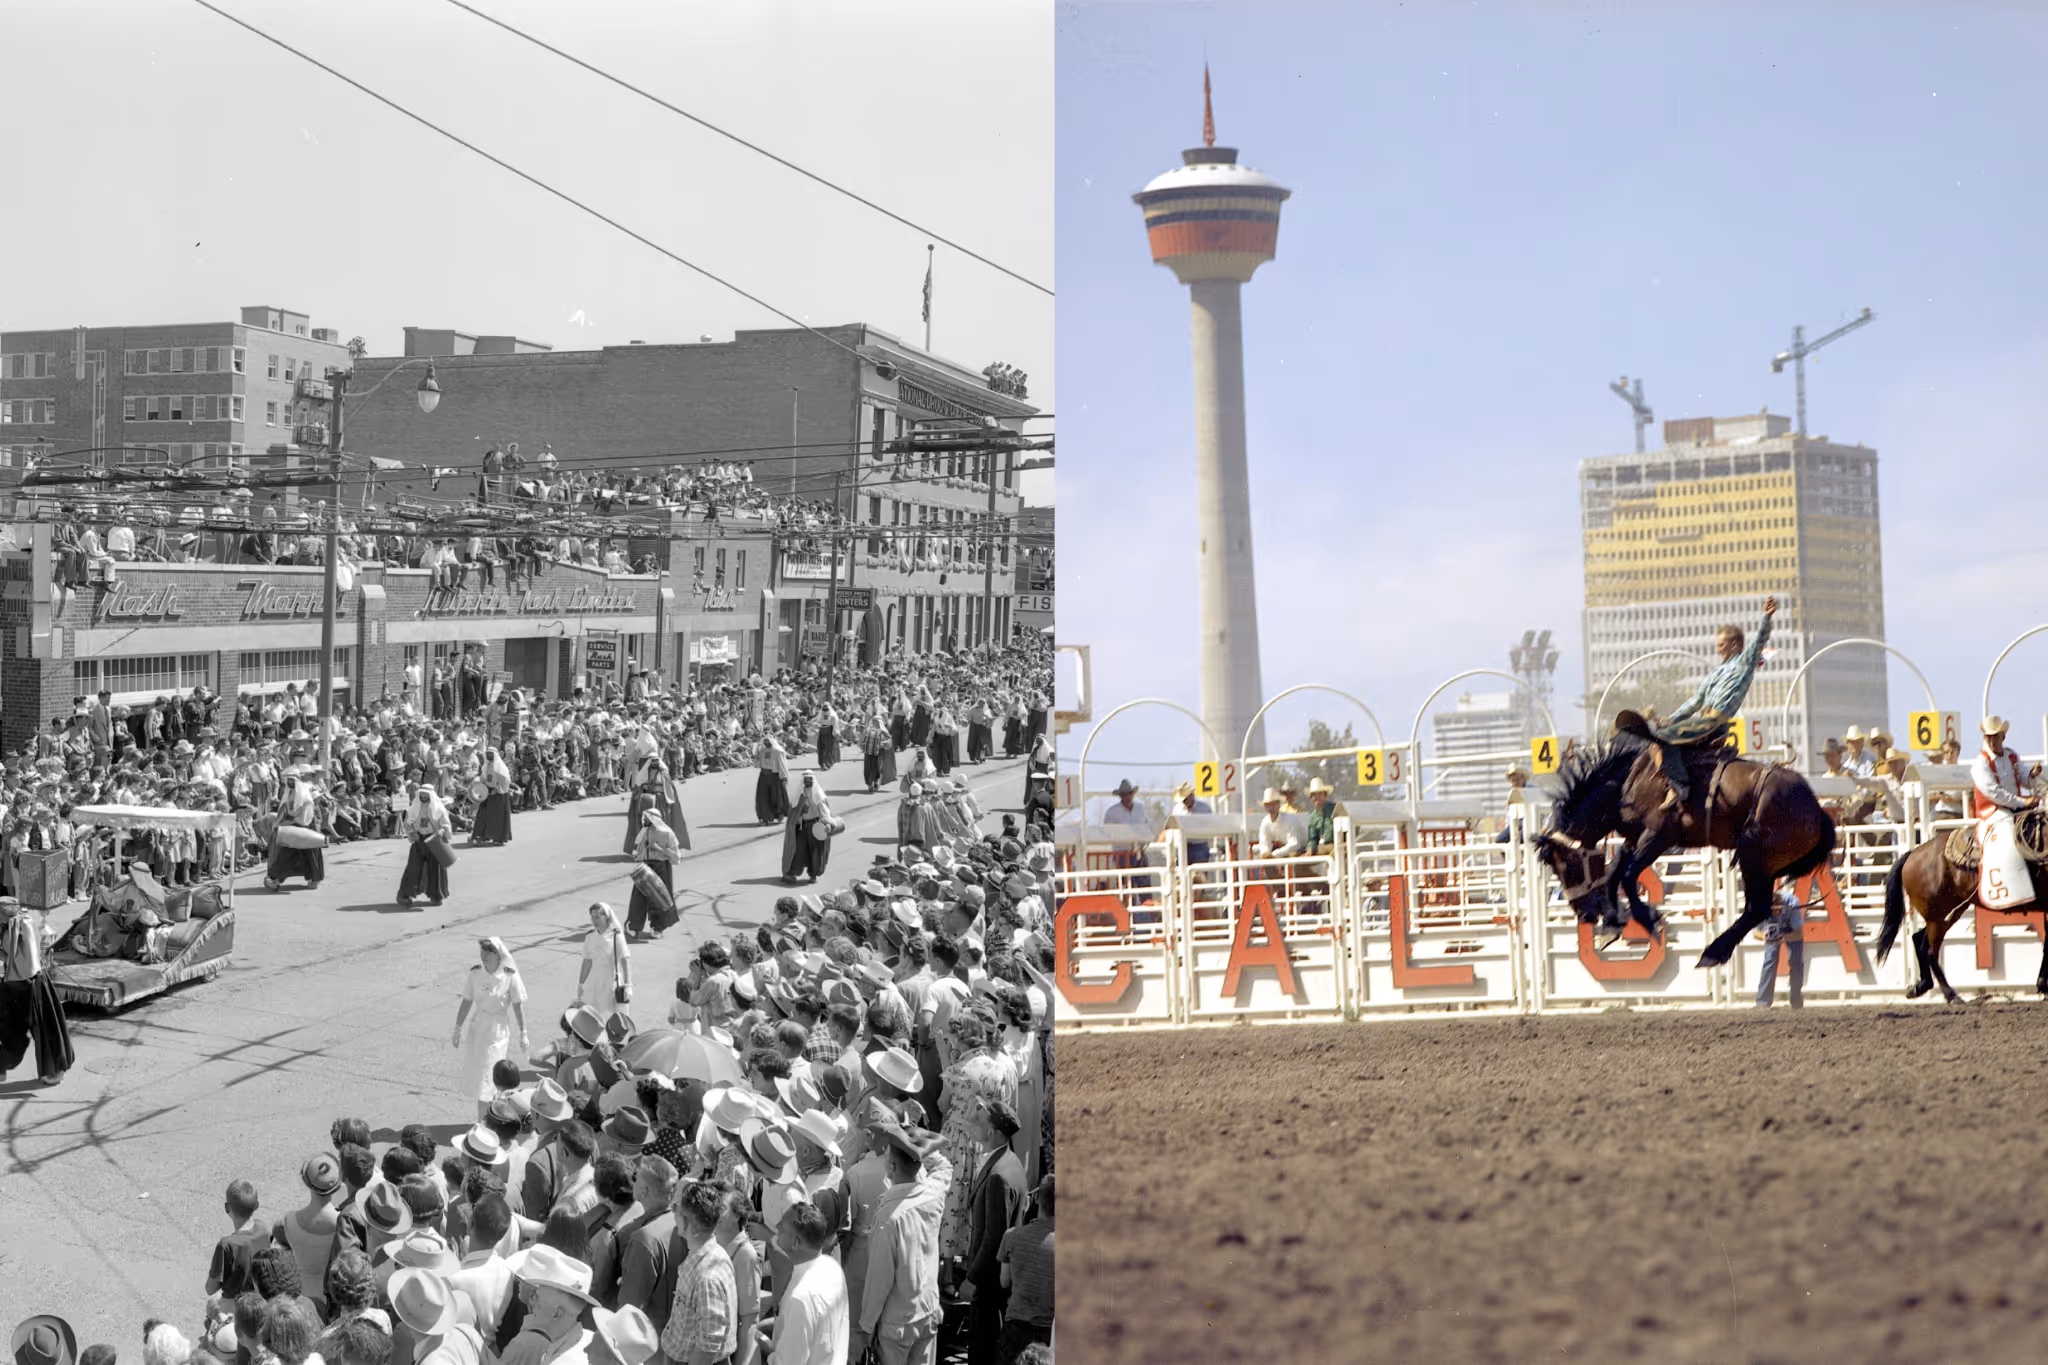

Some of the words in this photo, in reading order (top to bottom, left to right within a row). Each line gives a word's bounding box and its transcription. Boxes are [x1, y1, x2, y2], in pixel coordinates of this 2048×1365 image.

[899, 382, 926, 409] ATIONAL
[93, 576, 185, 616] Nash
[241, 580, 351, 614] Morrs
[520, 588, 561, 610] Nash
[567, 586, 635, 610] Limited
[835, 598, 869, 607] RINTERS
[589, 650, 613, 660] Nash
[1752, 720, 1763, 750] 5
[1917, 715, 1932, 746] 6
[1945, 713, 1956, 741] 6
[1365, 753, 1377, 781] 3
[1389, 752, 1400, 781] 3
[1538, 740, 1553, 769] 4
[1065, 777, 1072, 806] 1
[1201, 765, 1213, 792] 2
[1224, 763, 1236, 792] 2
